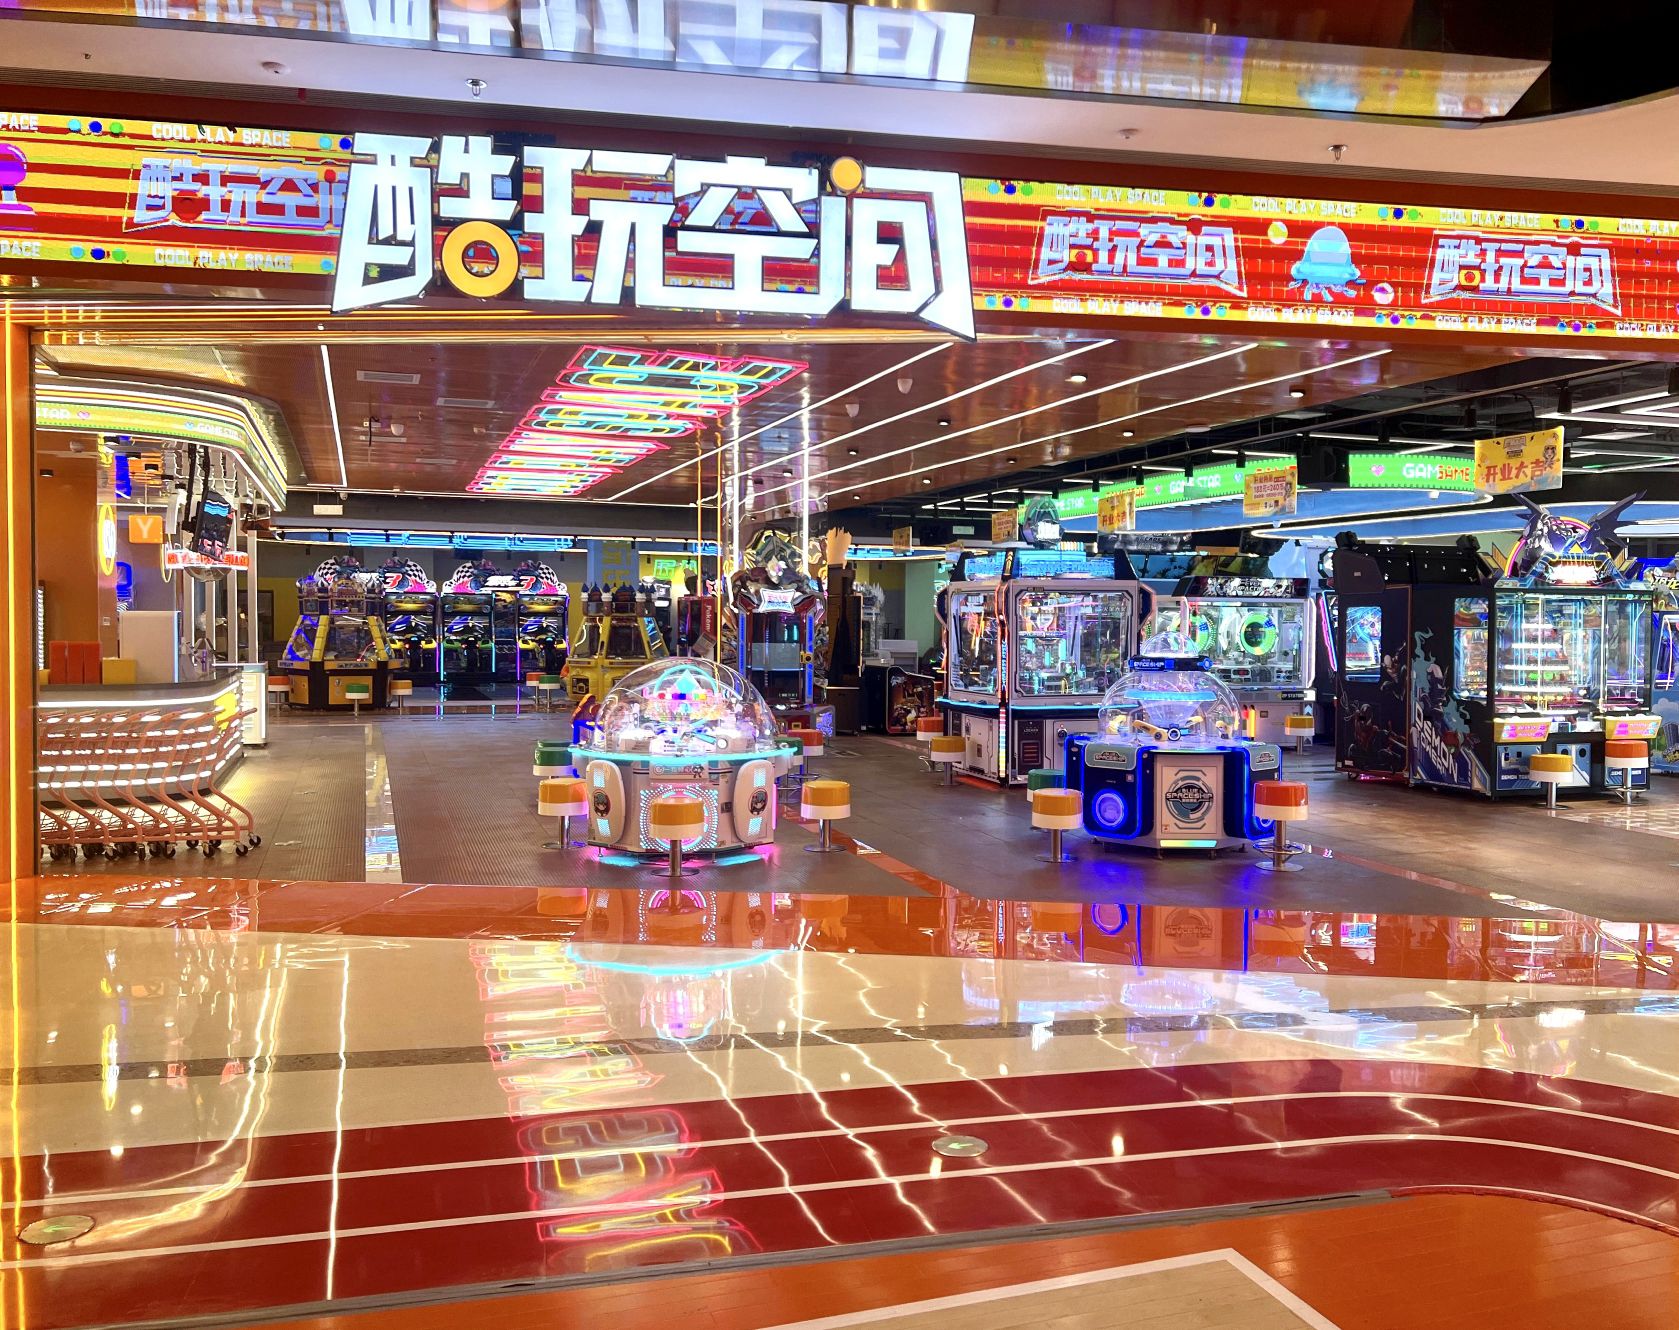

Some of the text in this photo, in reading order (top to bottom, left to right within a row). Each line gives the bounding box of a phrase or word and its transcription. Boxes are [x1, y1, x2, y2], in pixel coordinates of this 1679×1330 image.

[152, 123, 191, 141] COOL
[242, 129, 291, 147] SPACE
[1055, 185, 1166, 205] COOL PLAY SPACE
[1252, 197, 1357, 217] COOL PLAY SPACE
[1503, 213, 1541, 228] SPACE
[332, 133, 975, 339] 酷玩空间
[154, 248, 293, 270] COOL PLAY SPACE
[1037, 215, 1239, 284] 酷玩空间
[1429, 238, 1614, 304] 酷玩空间
[1053, 298, 1163, 316] COOL PLAY SPACE
[517, 345, 811, 438] SPACE
[1485, 459, 1545, 484] 开业大吉
